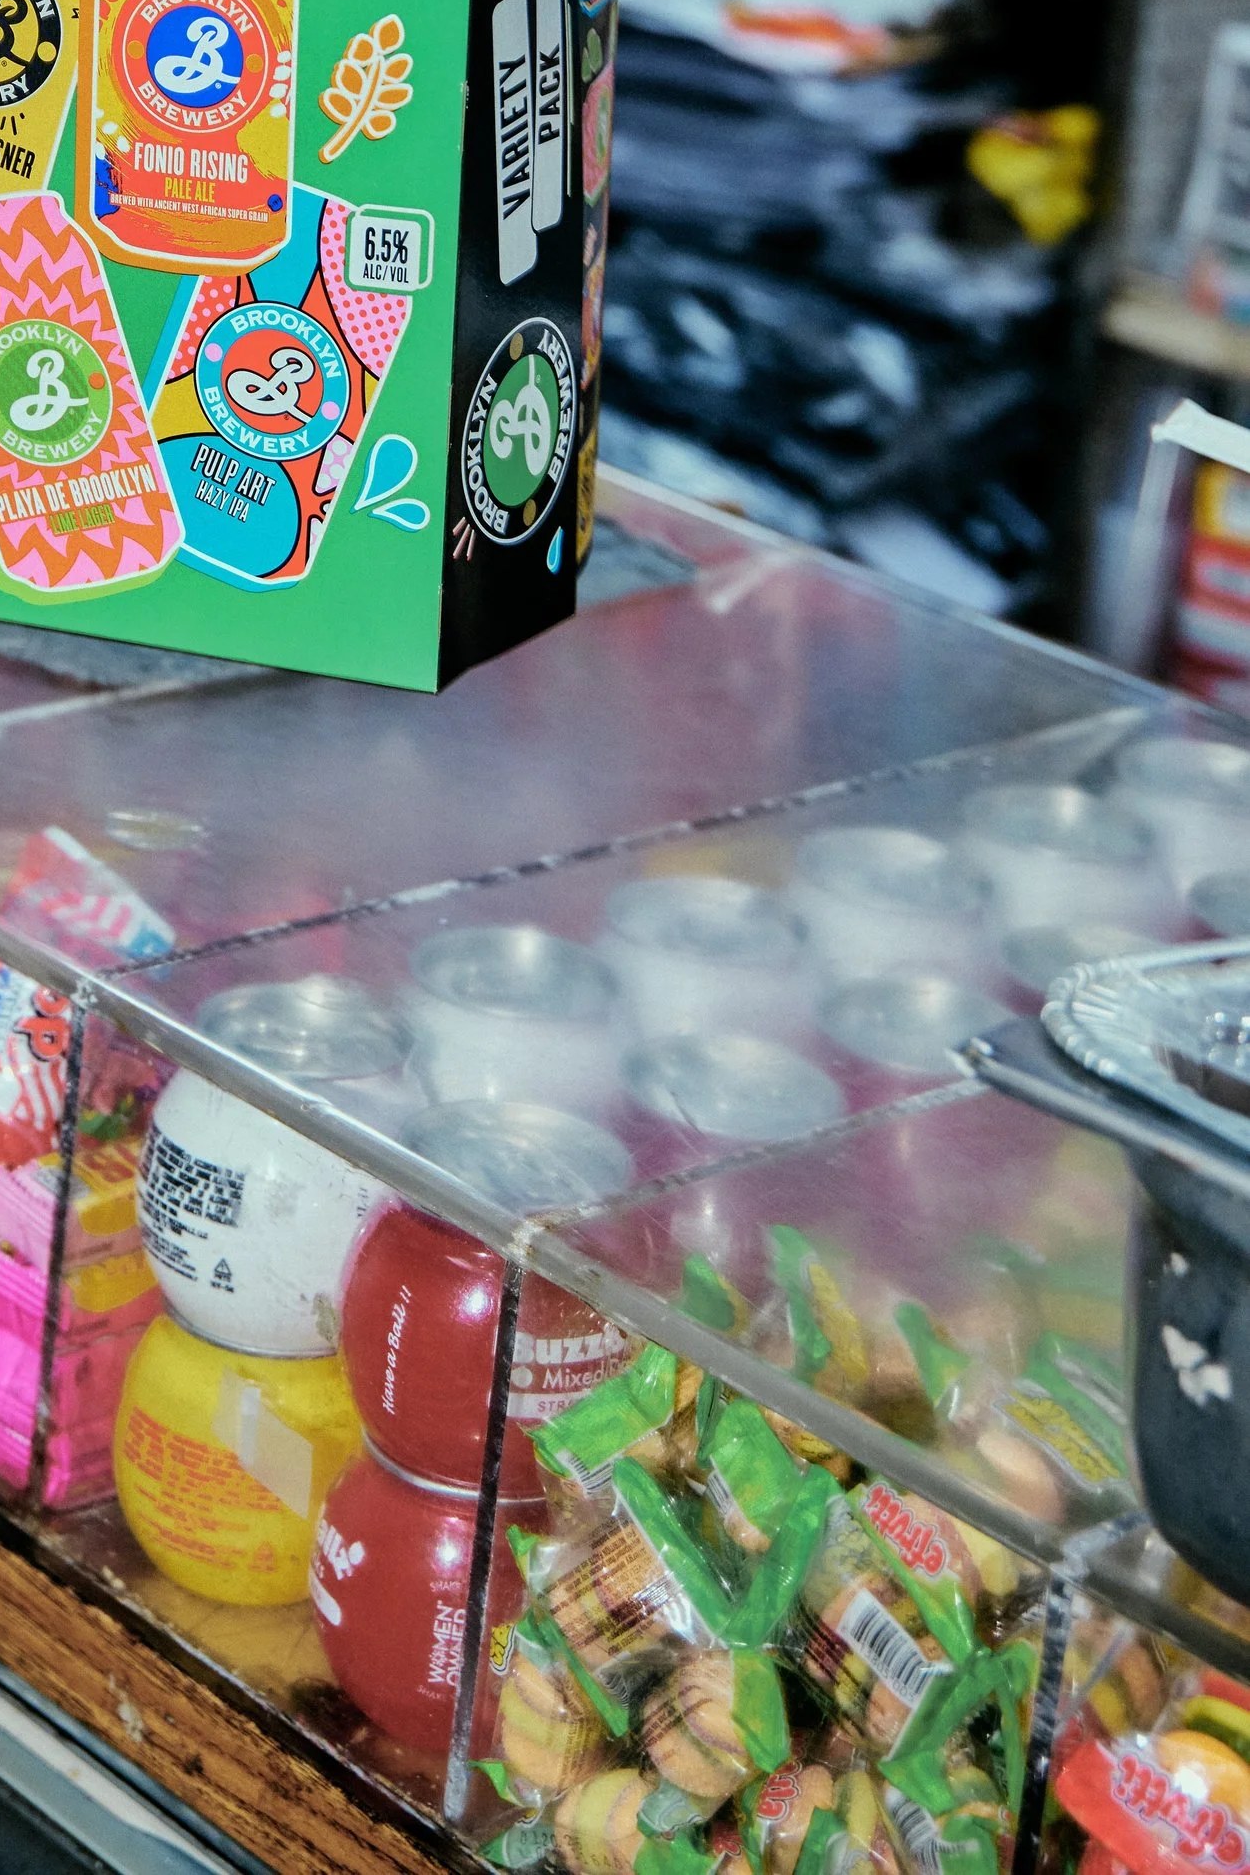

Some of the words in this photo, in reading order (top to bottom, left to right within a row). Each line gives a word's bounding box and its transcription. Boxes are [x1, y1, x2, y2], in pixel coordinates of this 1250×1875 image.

[137, 80, 249, 127] BREWERY
[537, 42, 562, 146] PACK
[498, 52, 528, 221] VARIETY
[133, 141, 185, 176] FONIO
[190, 148, 249, 184] RISING
[110, 193, 136, 206] BREWED
[136, 196, 154, 209] WITH
[154, 198, 182, 212] ANCIENT
[181, 202, 200, 215] WEST
[200, 205, 227, 218] AFRICAN
[227, 208, 249, 221] SUPER
[248, 210, 269, 223] GRAIN
[164, 176, 193, 201] PALE
[194, 181, 216, 204] ALE
[364, 226, 410, 265] 6.5%
[363, 261, 410, 284] ALC/VOL
[229, 308, 342, 380] BROOKLYN
[203, 385, 312, 454] BREWERY
[537, 328, 573, 484] BREWERY
[1, 412, 104, 460] BREWERY
[465, 373, 510, 536] BROOKLYN
[45, 482, 73, 512] DE
[72, 464, 157, 509] BROOKLYN
[192, 442, 240, 491] PULP
[239, 465, 277, 507] ART
[49, 510, 79, 535] LIME
[78, 502, 116, 531] LAGER
[195, 479, 230, 512] HAZY
[227, 495, 251, 524] IPA
[387, 1306, 407, 1350] Ball
[386, 1350, 398, 1369] a
[381, 1364, 398, 1416] Have
